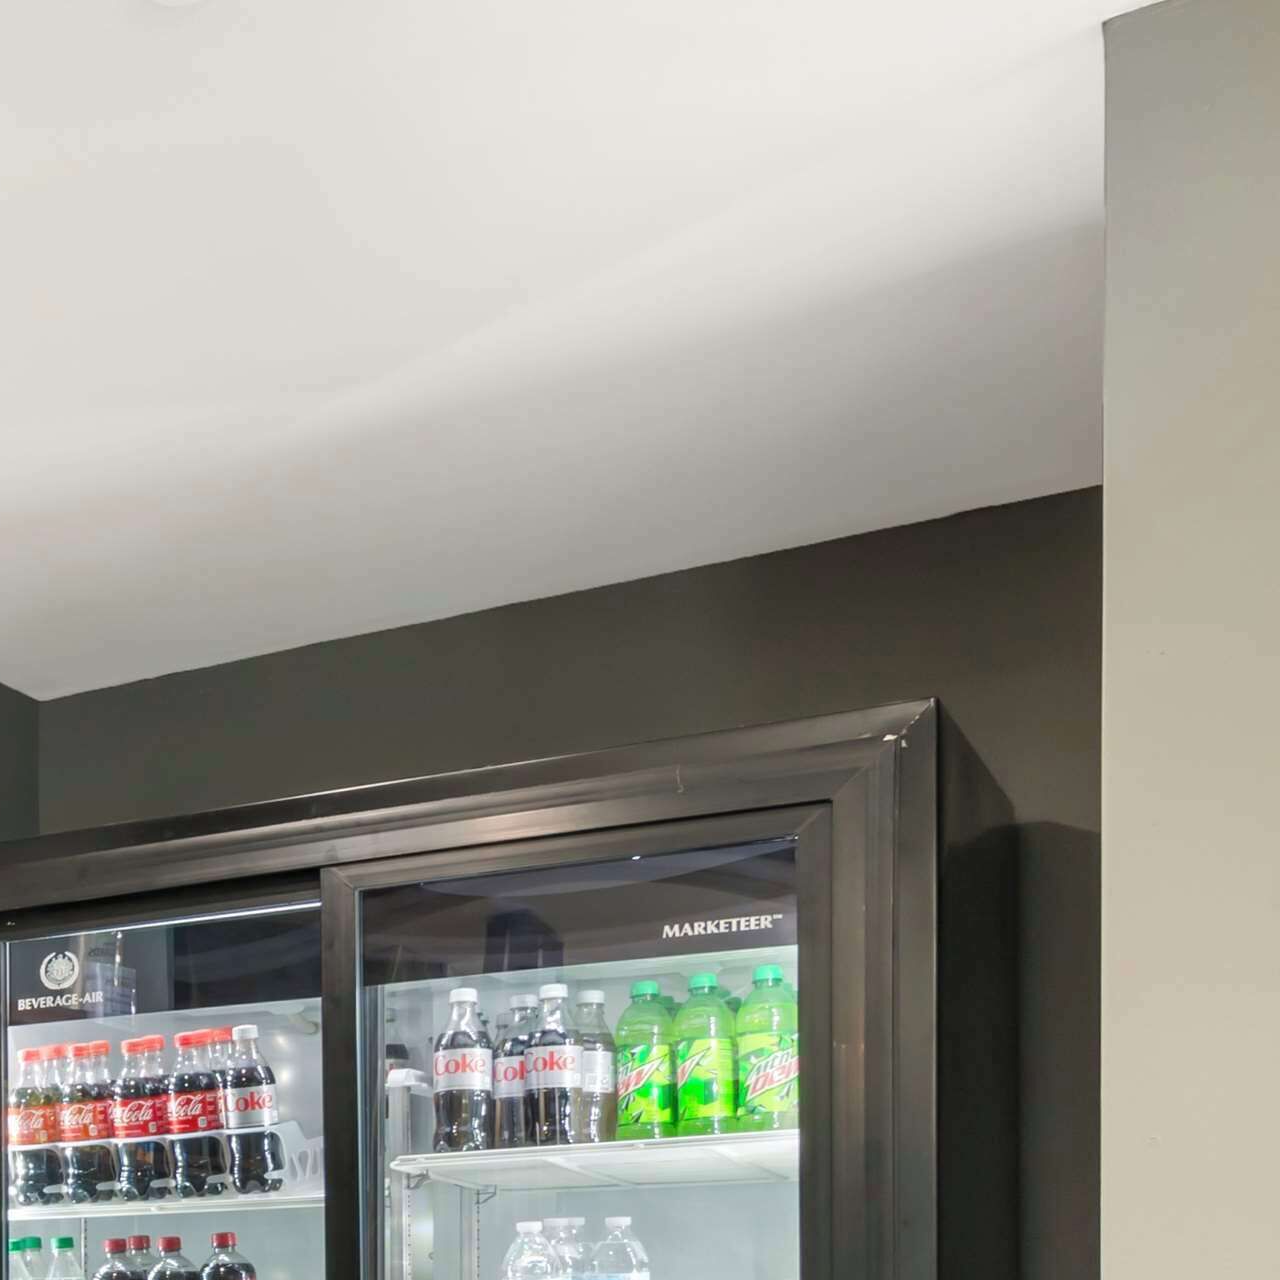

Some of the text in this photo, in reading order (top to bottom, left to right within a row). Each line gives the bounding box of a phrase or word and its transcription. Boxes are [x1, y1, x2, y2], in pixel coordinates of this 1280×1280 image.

[17, 991, 104, 1011] BEVERAGE-AIR
[435, 1053, 486, 1077] Coke
[525, 1050, 576, 1074] Coke
